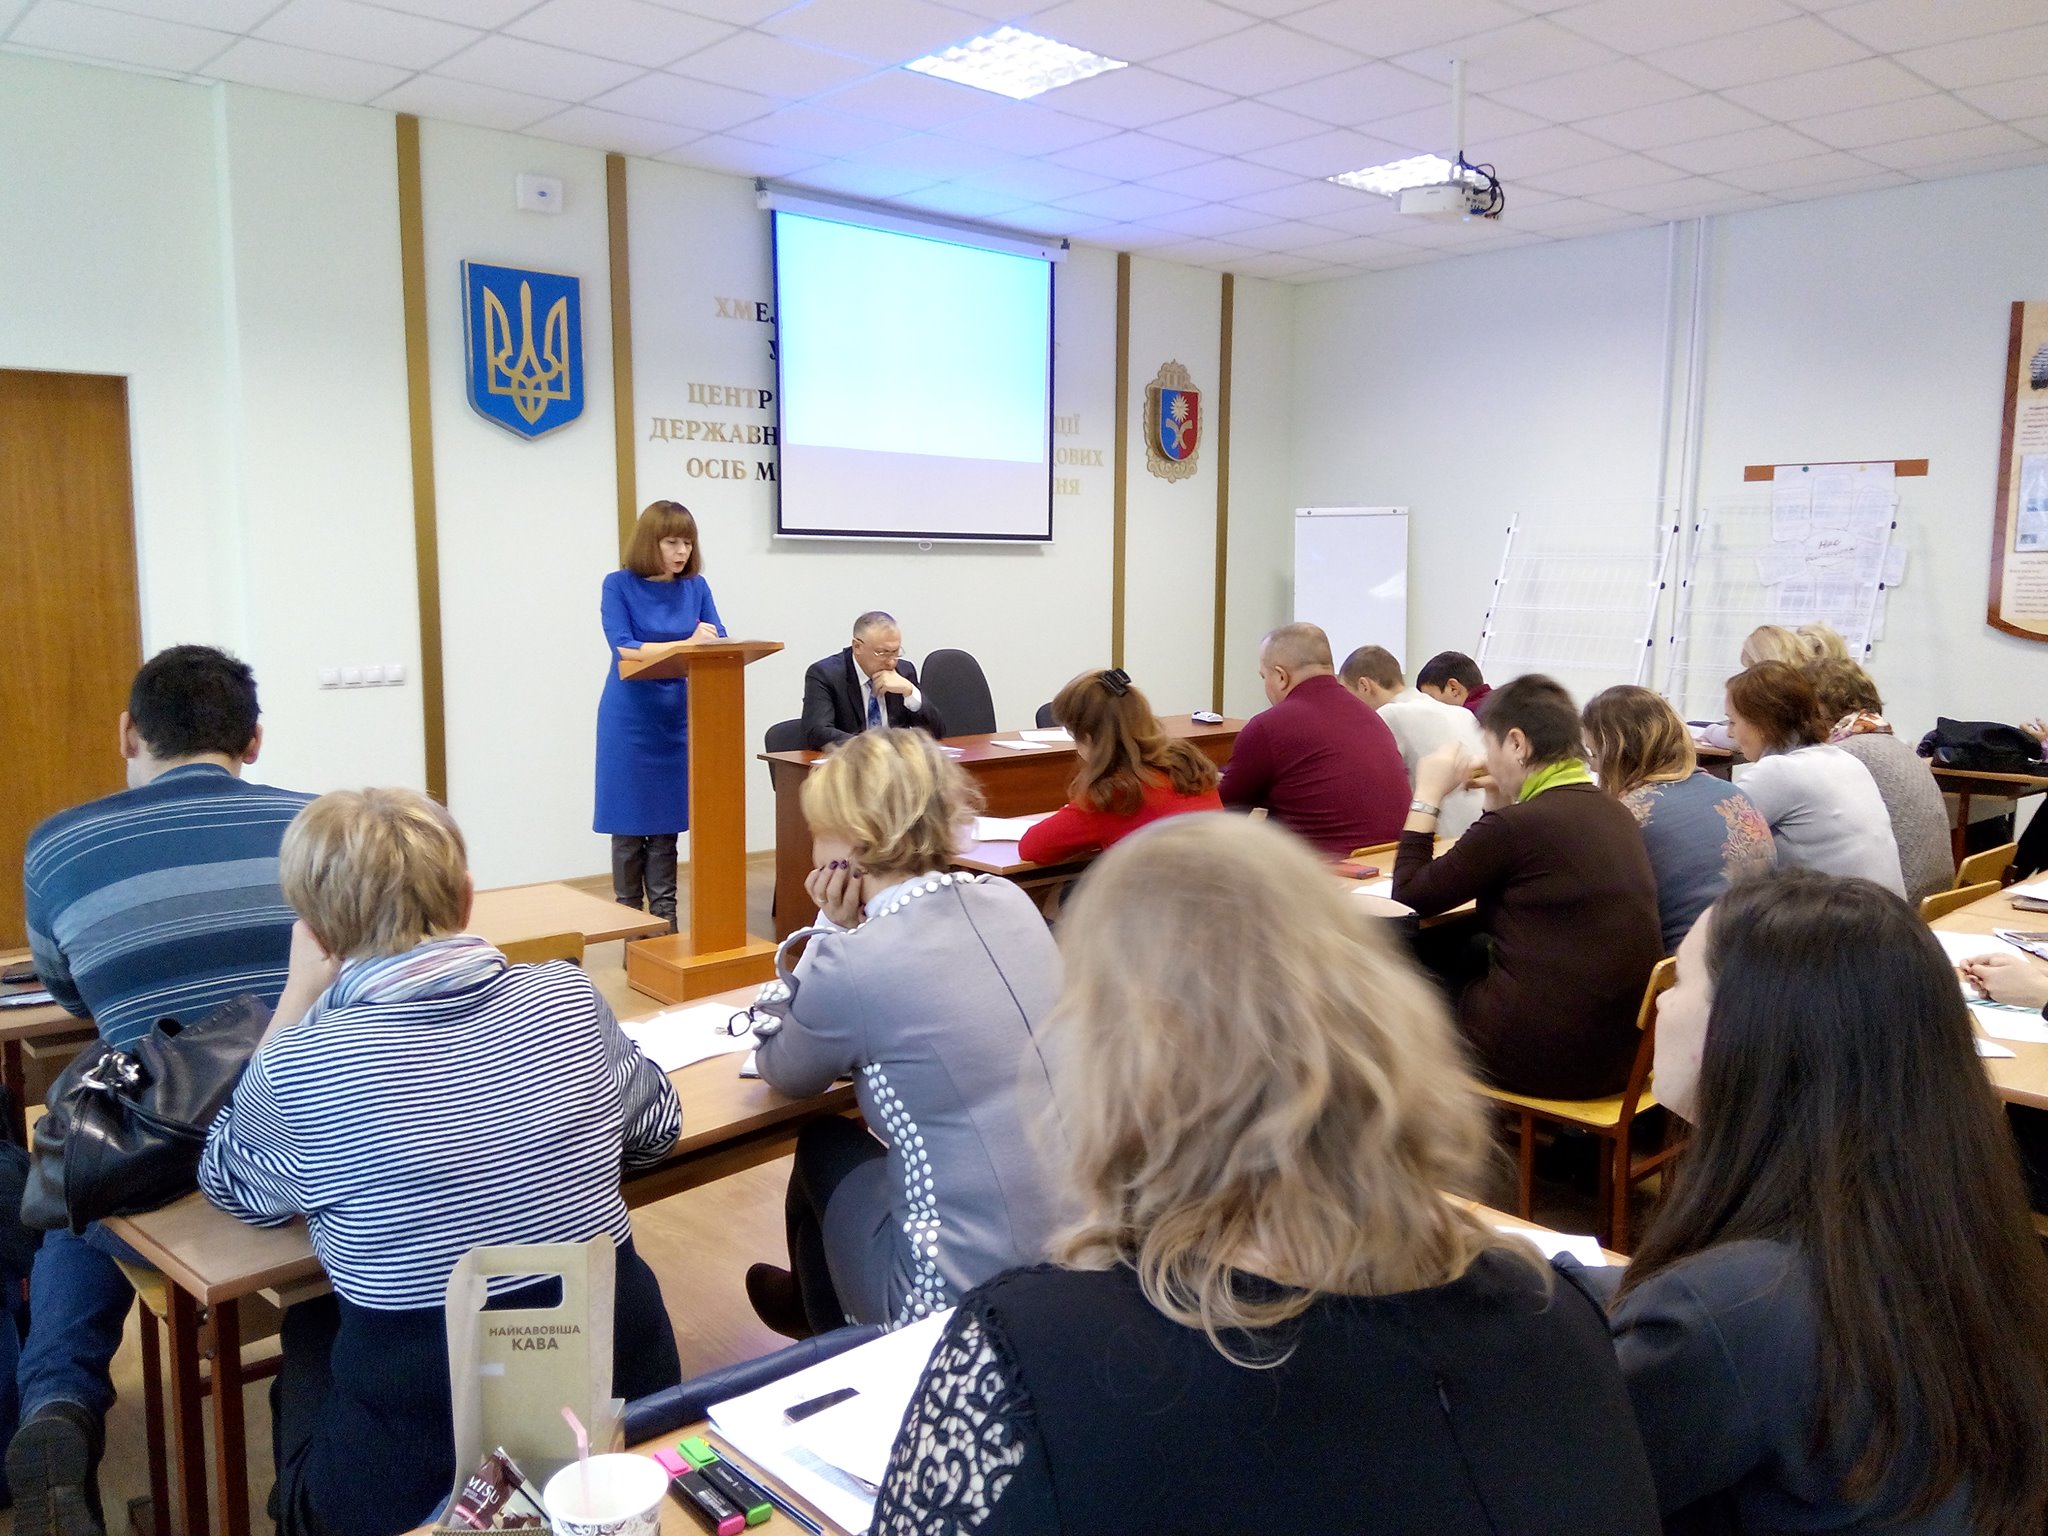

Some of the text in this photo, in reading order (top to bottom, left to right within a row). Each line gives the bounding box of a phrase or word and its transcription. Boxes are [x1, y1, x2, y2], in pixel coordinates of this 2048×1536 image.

[714, 296, 777, 324] ХМЕ
[687, 382, 773, 410] ЦЕНТР
[649, 417, 1104, 467] ДЕРЖАВН ОВИХ
[686, 457, 748, 480] ОСІБ
[489, 1324, 581, 1337] НАЙКАВОВІША
[512, 1337, 560, 1351] КАВА
